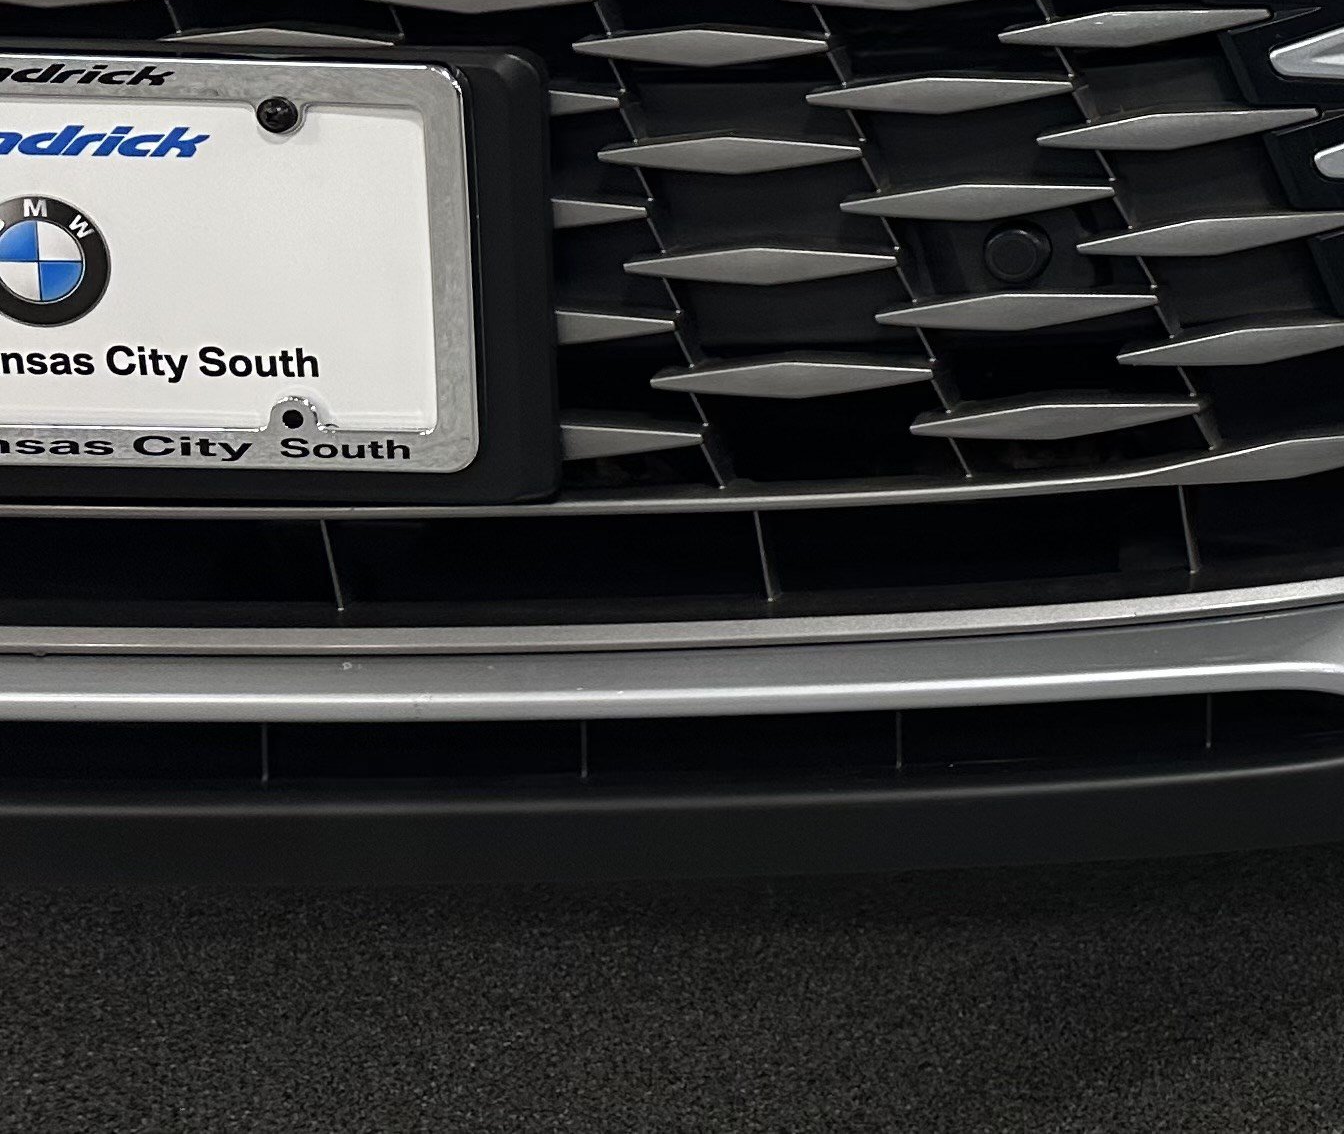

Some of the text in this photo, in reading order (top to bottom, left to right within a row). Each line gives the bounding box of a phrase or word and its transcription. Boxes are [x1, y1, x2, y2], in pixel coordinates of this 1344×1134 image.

[106, 345, 189, 383] City
[199, 348, 320, 378] South
[133, 435, 253, 462] City
[280, 438, 412, 460] South
